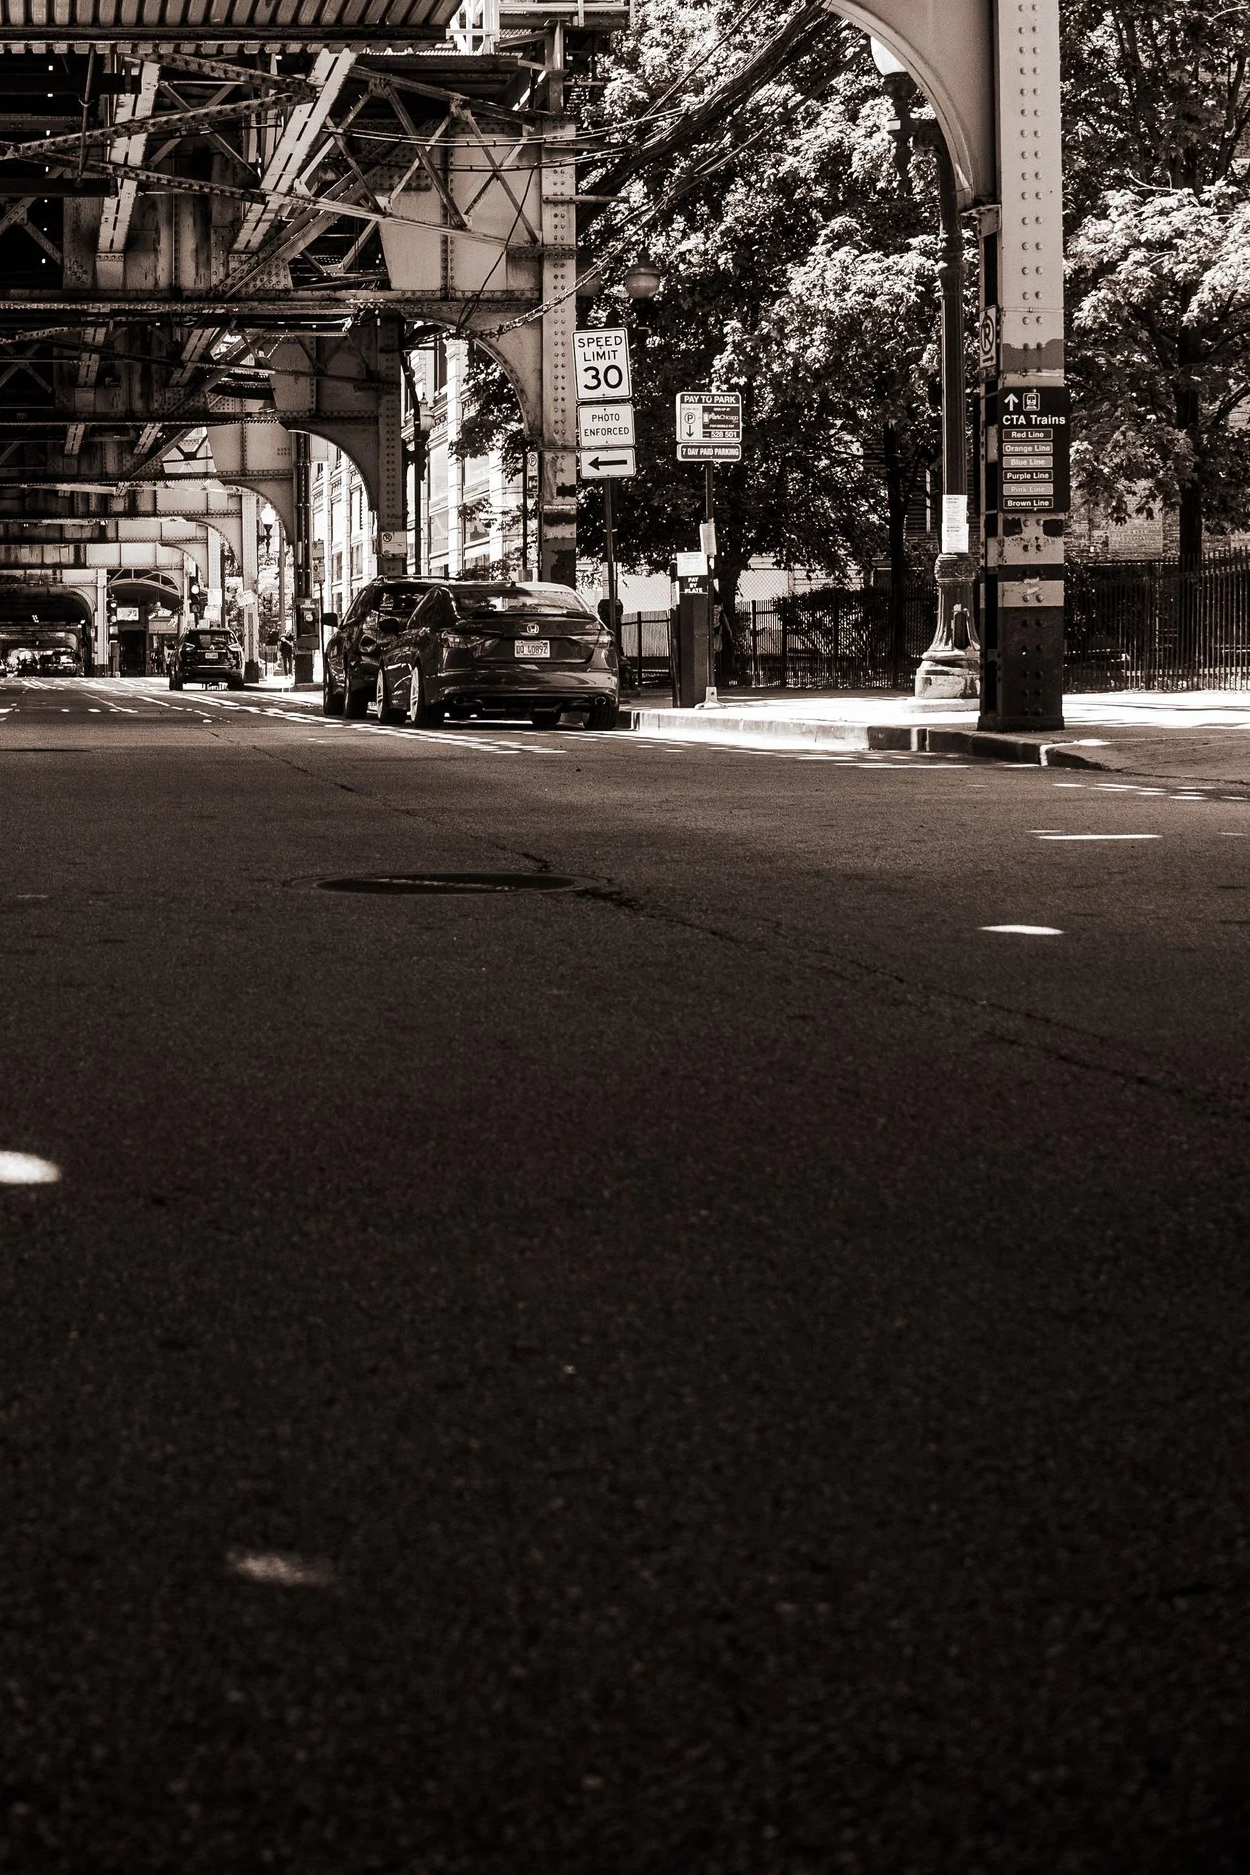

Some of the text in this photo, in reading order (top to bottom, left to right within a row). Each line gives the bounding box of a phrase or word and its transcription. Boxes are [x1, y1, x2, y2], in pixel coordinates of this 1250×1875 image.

[577, 335, 623, 348] SPEED
[583, 350, 618, 362] LIMIT
[583, 364, 623, 390] 30
[684, 395, 736, 403] PAY TO PARK
[591, 413, 621, 422] PHOTO
[1002, 414, 1066, 425] CTA Trains
[584, 427, 630, 437] ENFORCED
[682, 448, 739, 456] 7 DAY PAID PARKING
[1005, 444, 1050, 453] Orange Line
[1010, 458, 1045, 466] Blue Line
[1006, 472, 1031, 481] Purple
[1007, 499, 1049, 507] Brown Line
